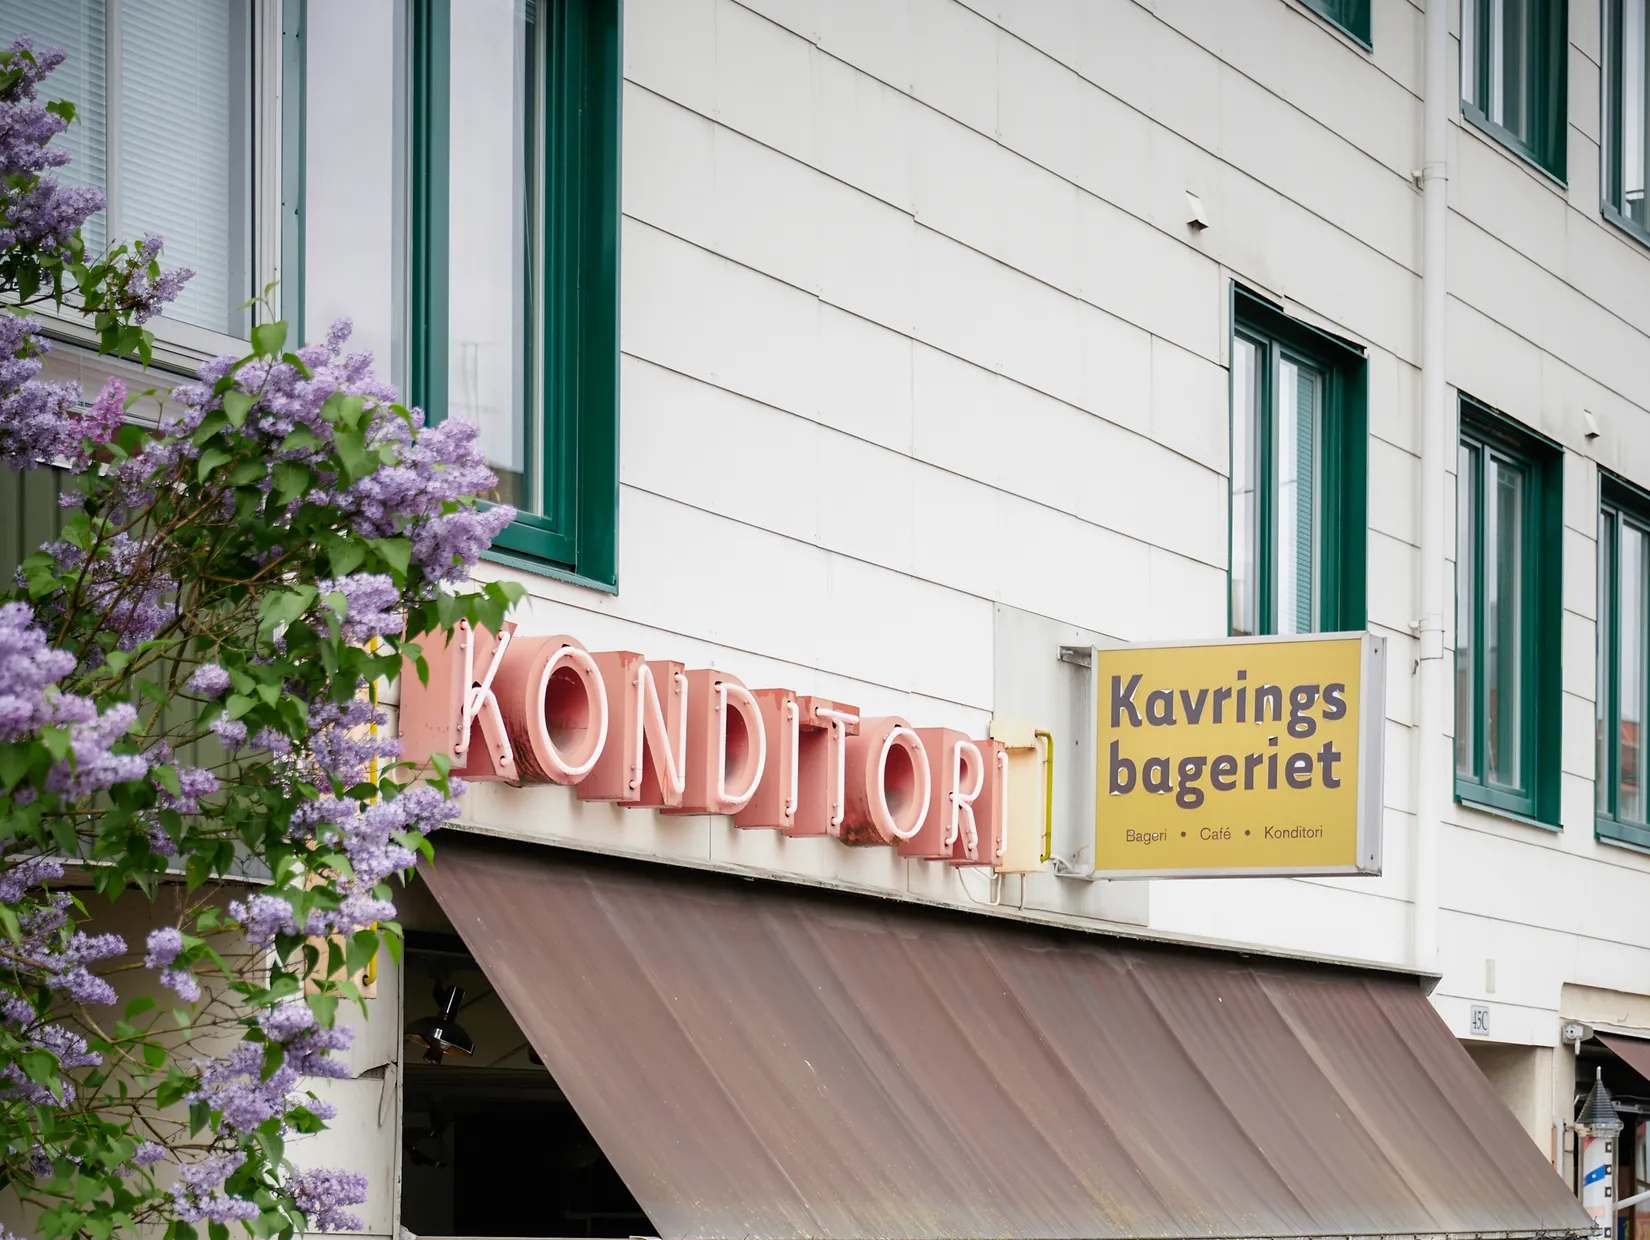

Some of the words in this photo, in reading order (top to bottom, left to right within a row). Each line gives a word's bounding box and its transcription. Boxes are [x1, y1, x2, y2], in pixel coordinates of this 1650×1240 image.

[399, 602, 1008, 868] KONDITORI
[1110, 669, 1347, 739] Kavrings
[1109, 736, 1342, 810] bageriet
[1125, 828, 1168, 846] Bageri
[1200, 826, 1232, 842] Café
[1264, 825, 1324, 840] Konditori
[1472, 1010, 1488, 1031] 45C
